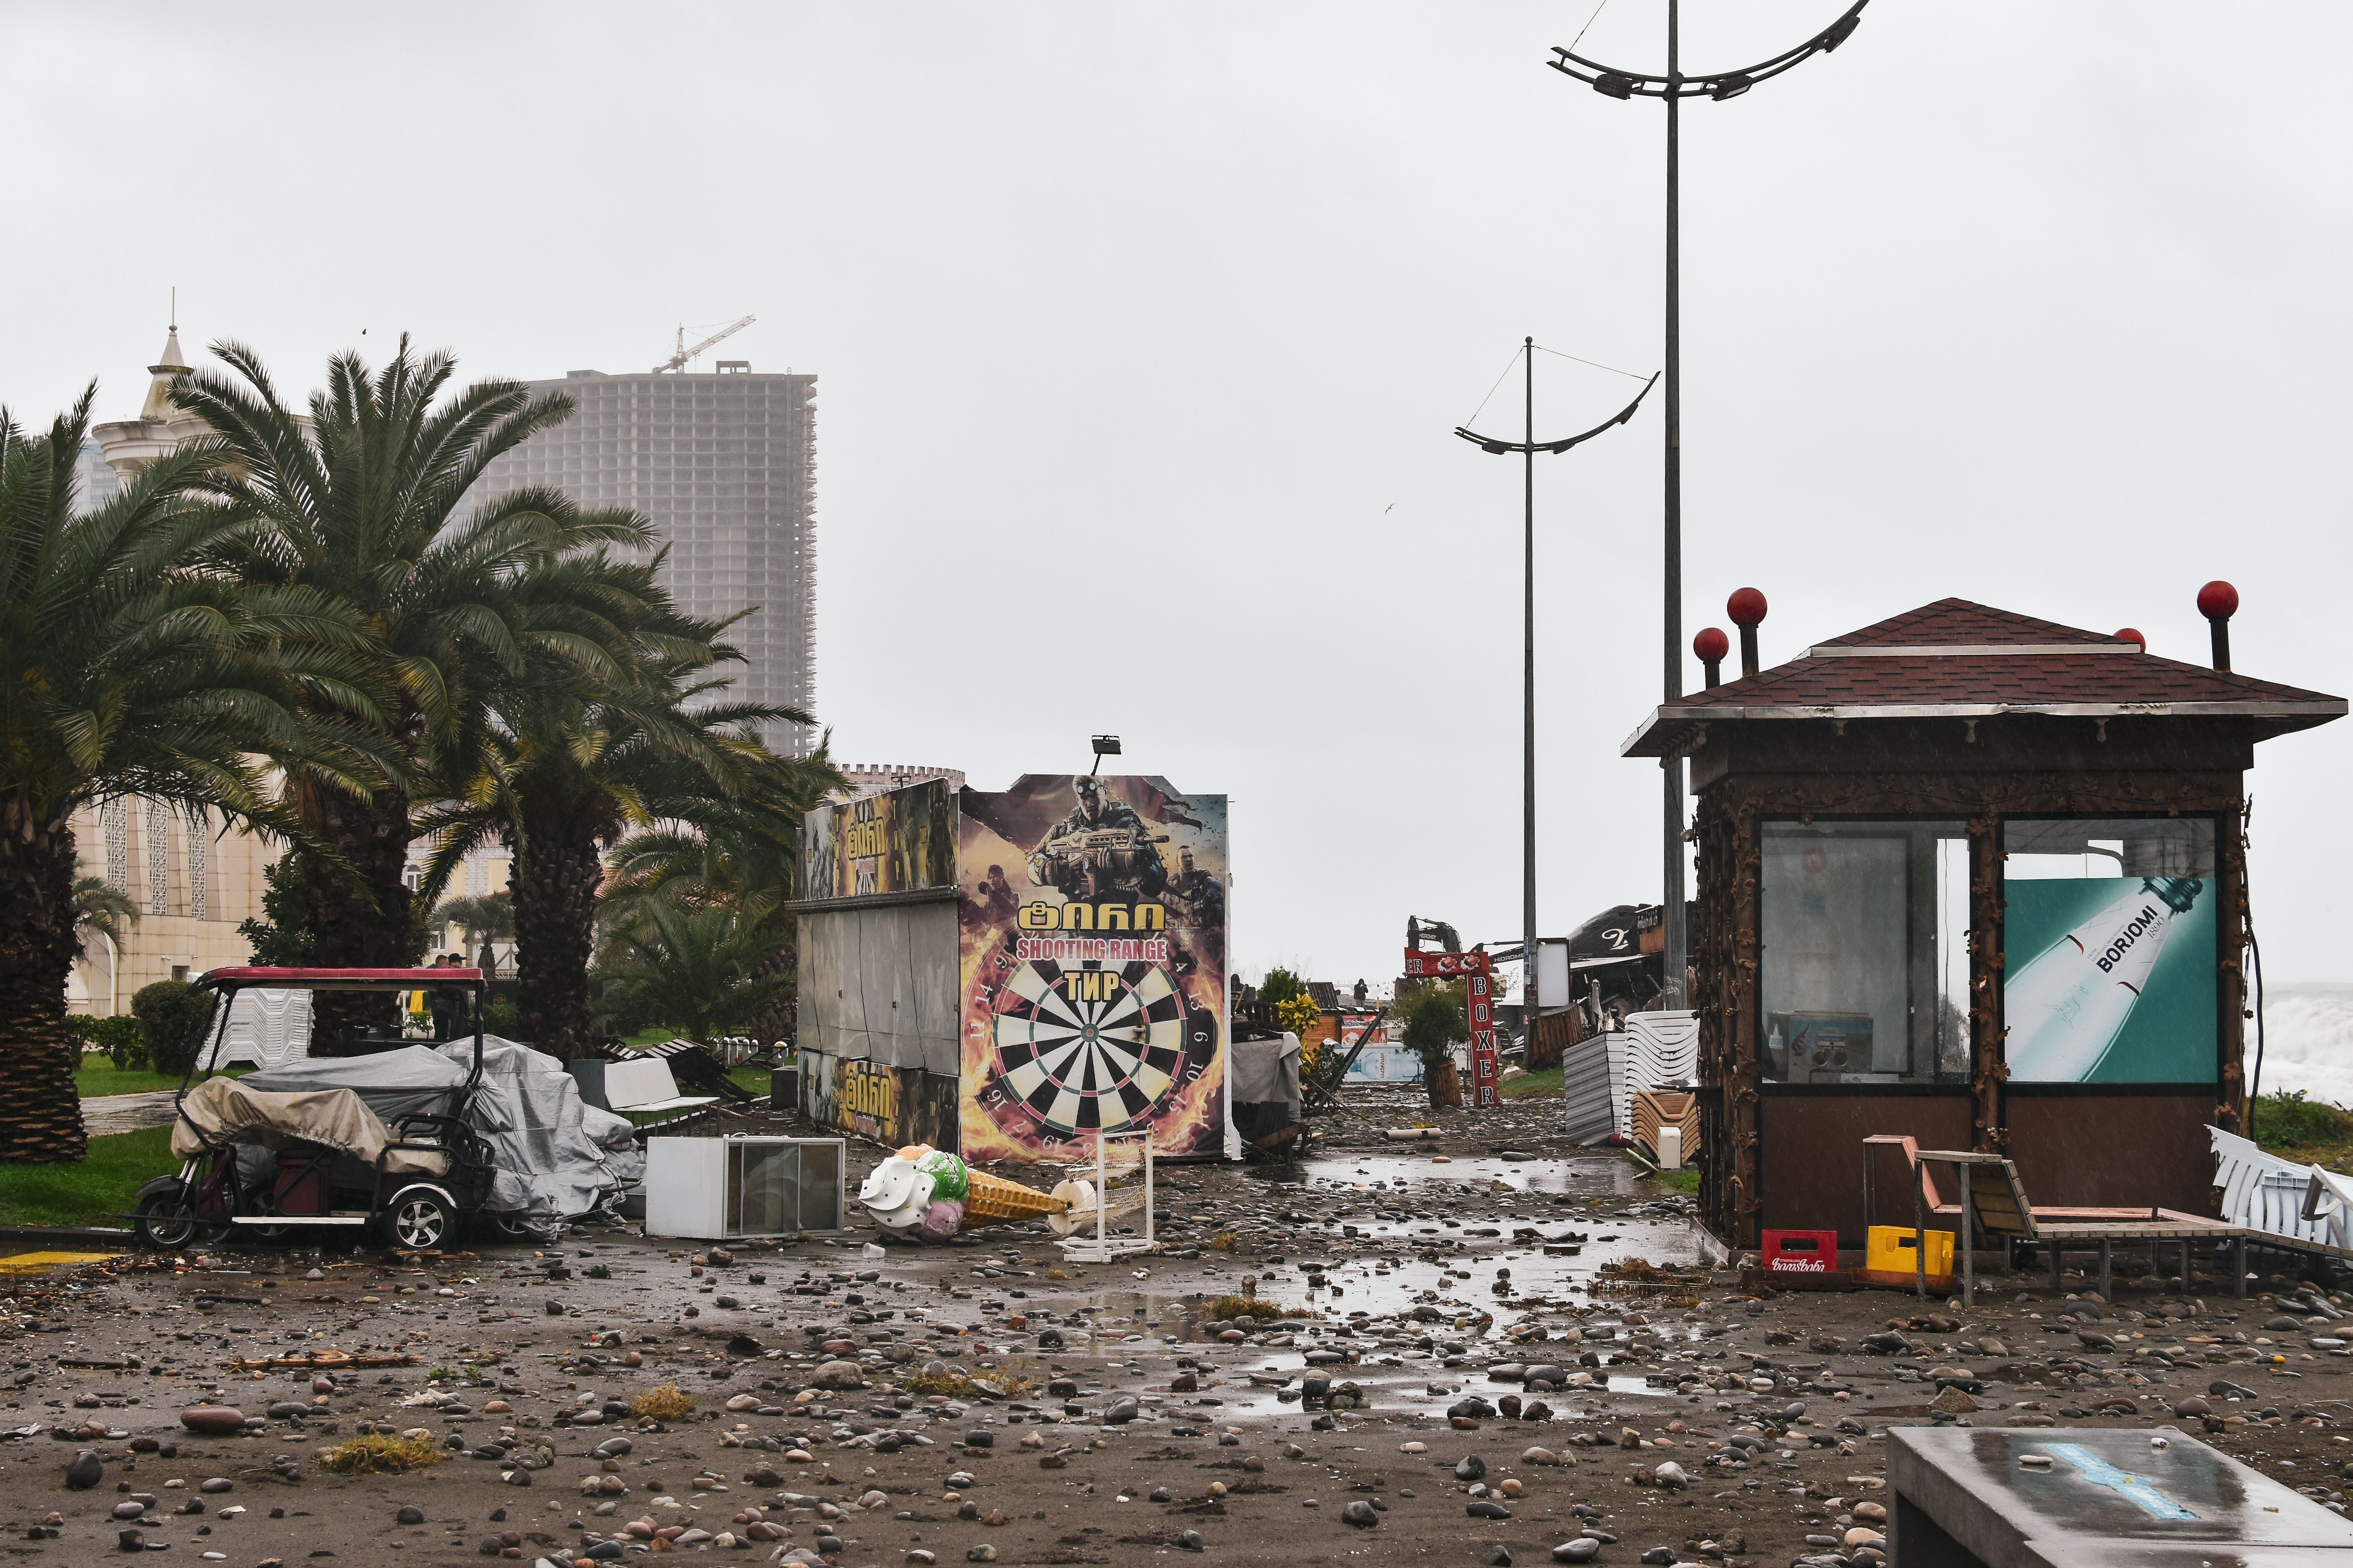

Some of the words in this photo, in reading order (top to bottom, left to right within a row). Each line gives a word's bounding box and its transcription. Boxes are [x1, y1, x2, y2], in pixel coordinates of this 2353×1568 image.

[1017, 901, 1166, 930] ტირი
[2147, 917, 2165, 938] 1890
[1017, 938, 1106, 960] SHOOTING
[1110, 939, 1167, 961] RANGE
[2092, 944, 2108, 962] GEORGIAN
[2107, 925, 2125, 946] MOUNTAINS
[2096, 905, 2158, 973] BORJOMI
[2087, 948, 2097, 959] FROM
[1406, 959, 1424, 974] ER
[975, 983, 993, 1005] 14
[1064, 971, 1120, 1001] ТИР
[1187, 990, 1205, 1011] 13
[970, 1021, 985, 1040] 11
[1473, 977, 1494, 1104] BOXER
[1186, 1060, 1204, 1082] 10
[986, 1089, 1009, 1112] 16
[1168, 1093, 1187, 1116] 15
[1012, 1120, 1027, 1134] 7
[1042, 1135, 1064, 1153] 19
